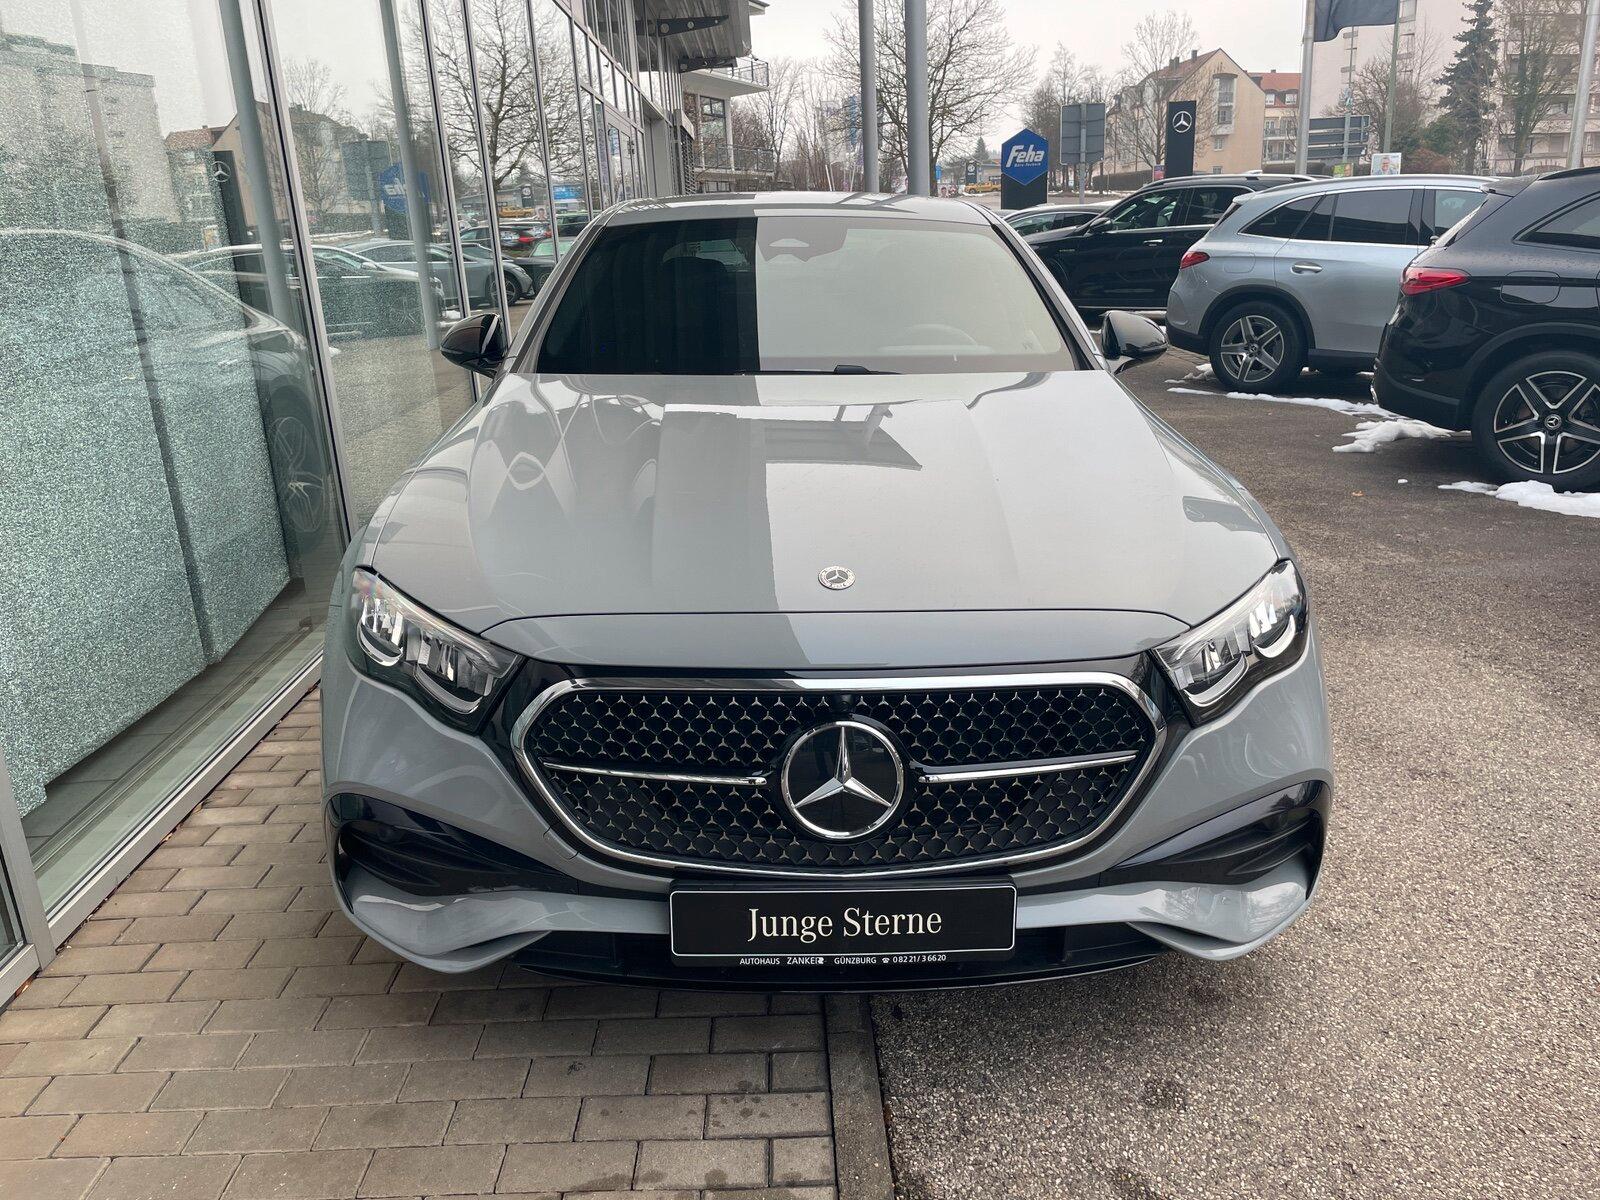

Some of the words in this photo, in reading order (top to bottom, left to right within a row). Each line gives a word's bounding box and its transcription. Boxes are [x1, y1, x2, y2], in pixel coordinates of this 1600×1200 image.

[1005, 145, 1045, 168] Feha
[748, 908, 833, 943] Junge
[843, 907, 942, 937] Sterne
[739, 957, 780, 965] AUTOHAUS
[834, 956, 877, 965] GÜNZBURG
